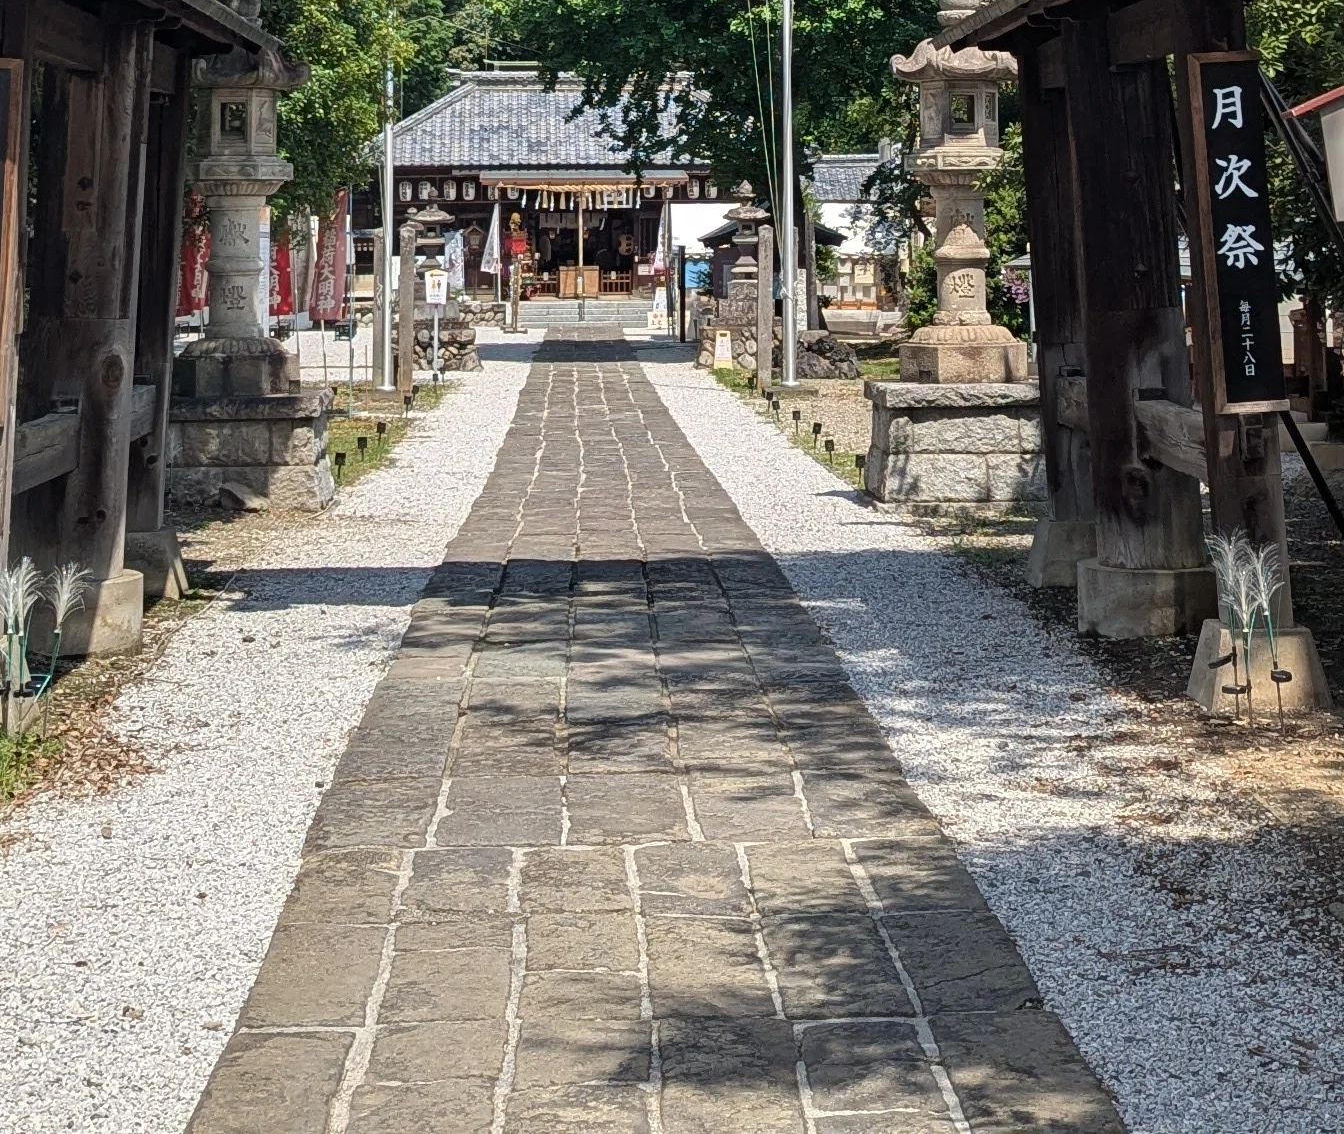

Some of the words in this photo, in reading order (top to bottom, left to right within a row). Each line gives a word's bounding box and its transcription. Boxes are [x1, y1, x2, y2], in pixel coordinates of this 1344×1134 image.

[1211, 85, 1265, 269] 月次祭
[1239, 299, 1257, 376] 毎月二十八日
